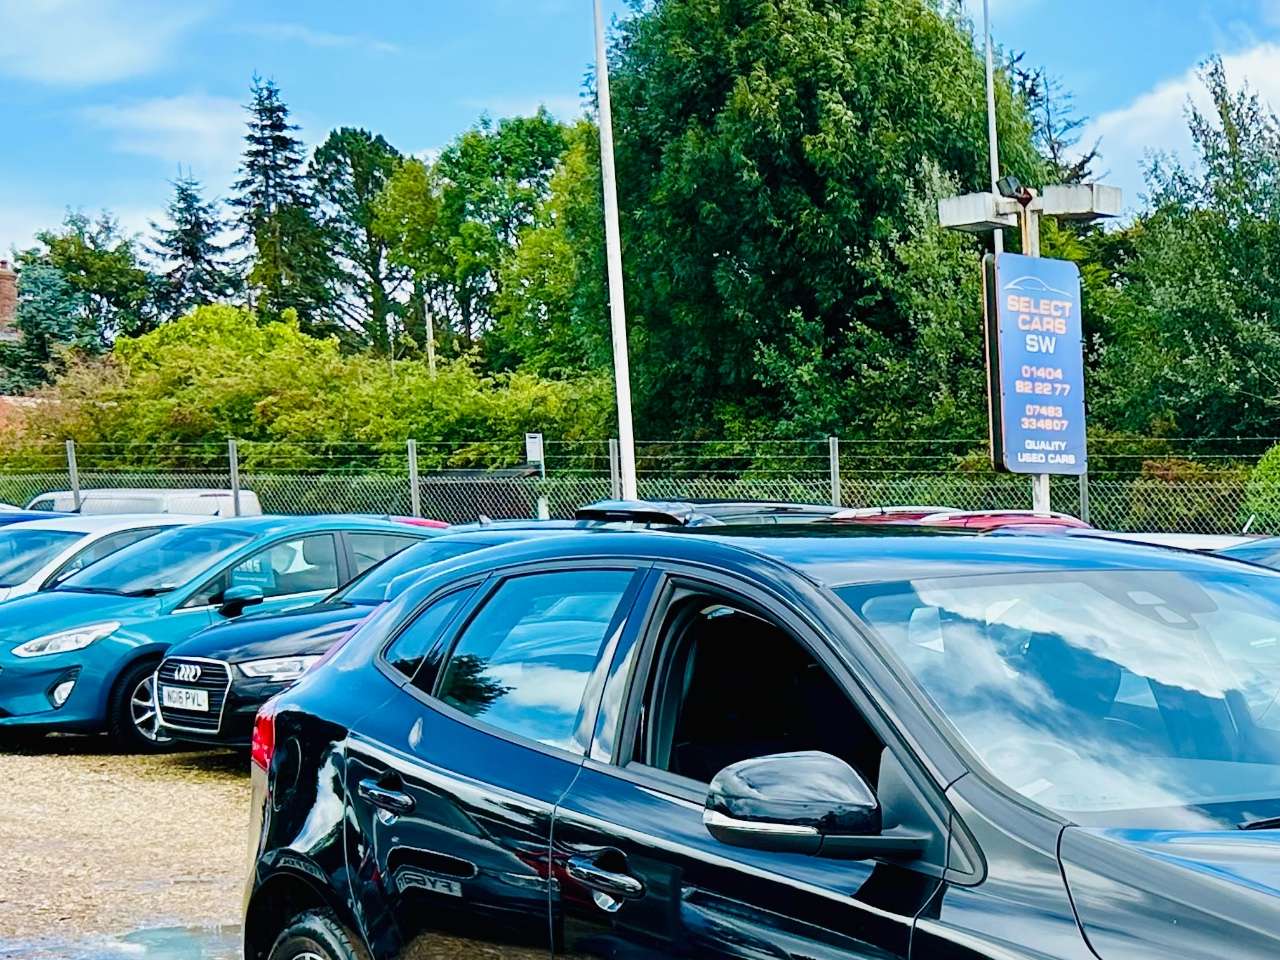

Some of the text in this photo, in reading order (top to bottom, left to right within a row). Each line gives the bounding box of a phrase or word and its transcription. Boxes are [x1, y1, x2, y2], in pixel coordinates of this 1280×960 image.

[1007, 295, 1072, 317] SELECT
[1018, 314, 1066, 334] CARS
[1025, 334, 1056, 354] SW
[1021, 365, 1062, 380] 01404
[1015, 380, 1071, 396] 82 22 77
[1025, 439, 1067, 451] QUALITY
[1017, 452, 1076, 465] USED CARS
